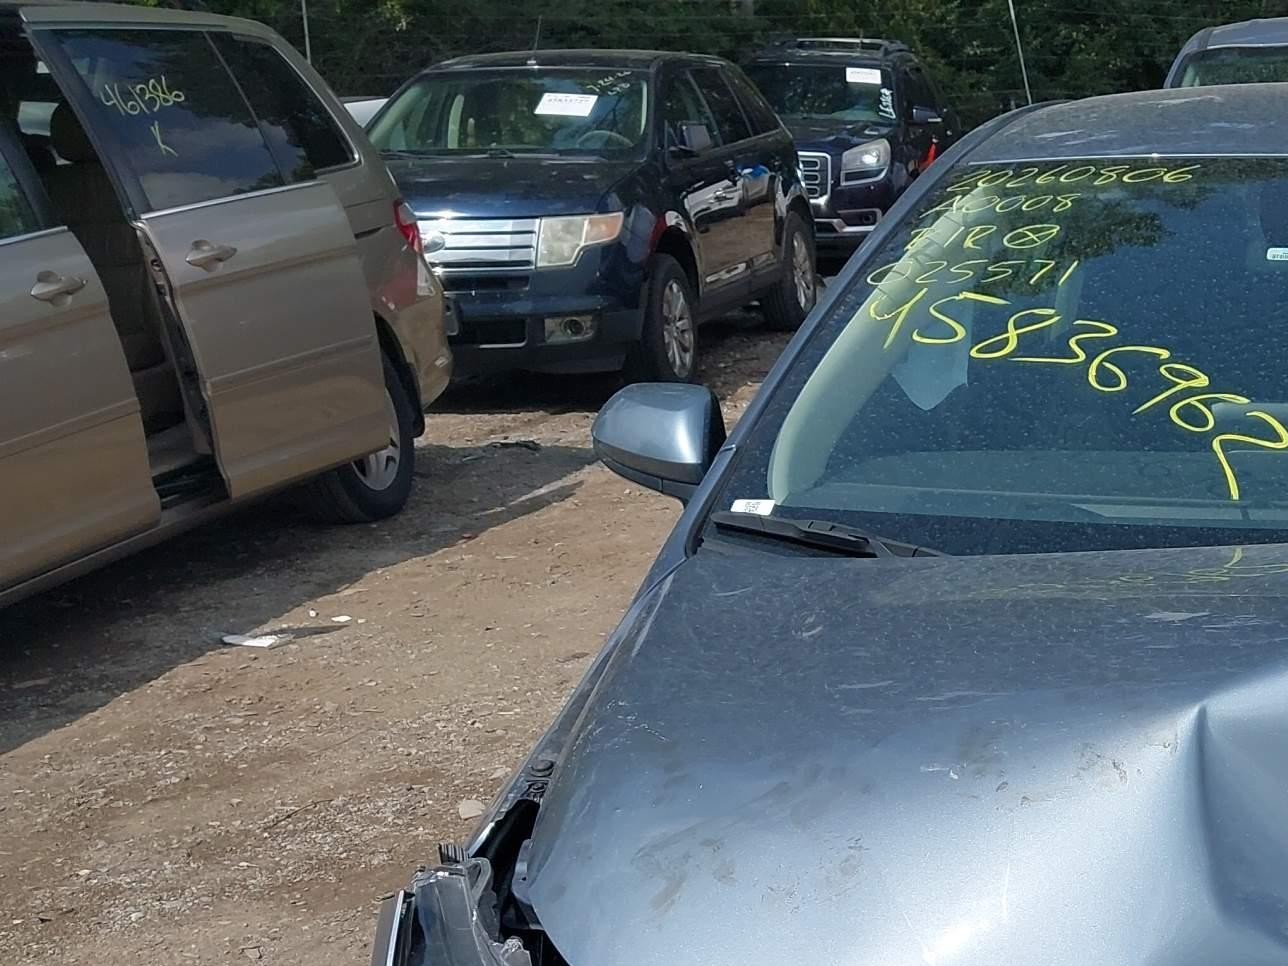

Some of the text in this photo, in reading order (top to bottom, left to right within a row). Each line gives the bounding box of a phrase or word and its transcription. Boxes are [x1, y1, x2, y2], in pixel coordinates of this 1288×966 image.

[100, 74, 185, 116] 461386
[945, 164, 1201, 193] 20260806
[866, 259, 1080, 287] 025571
